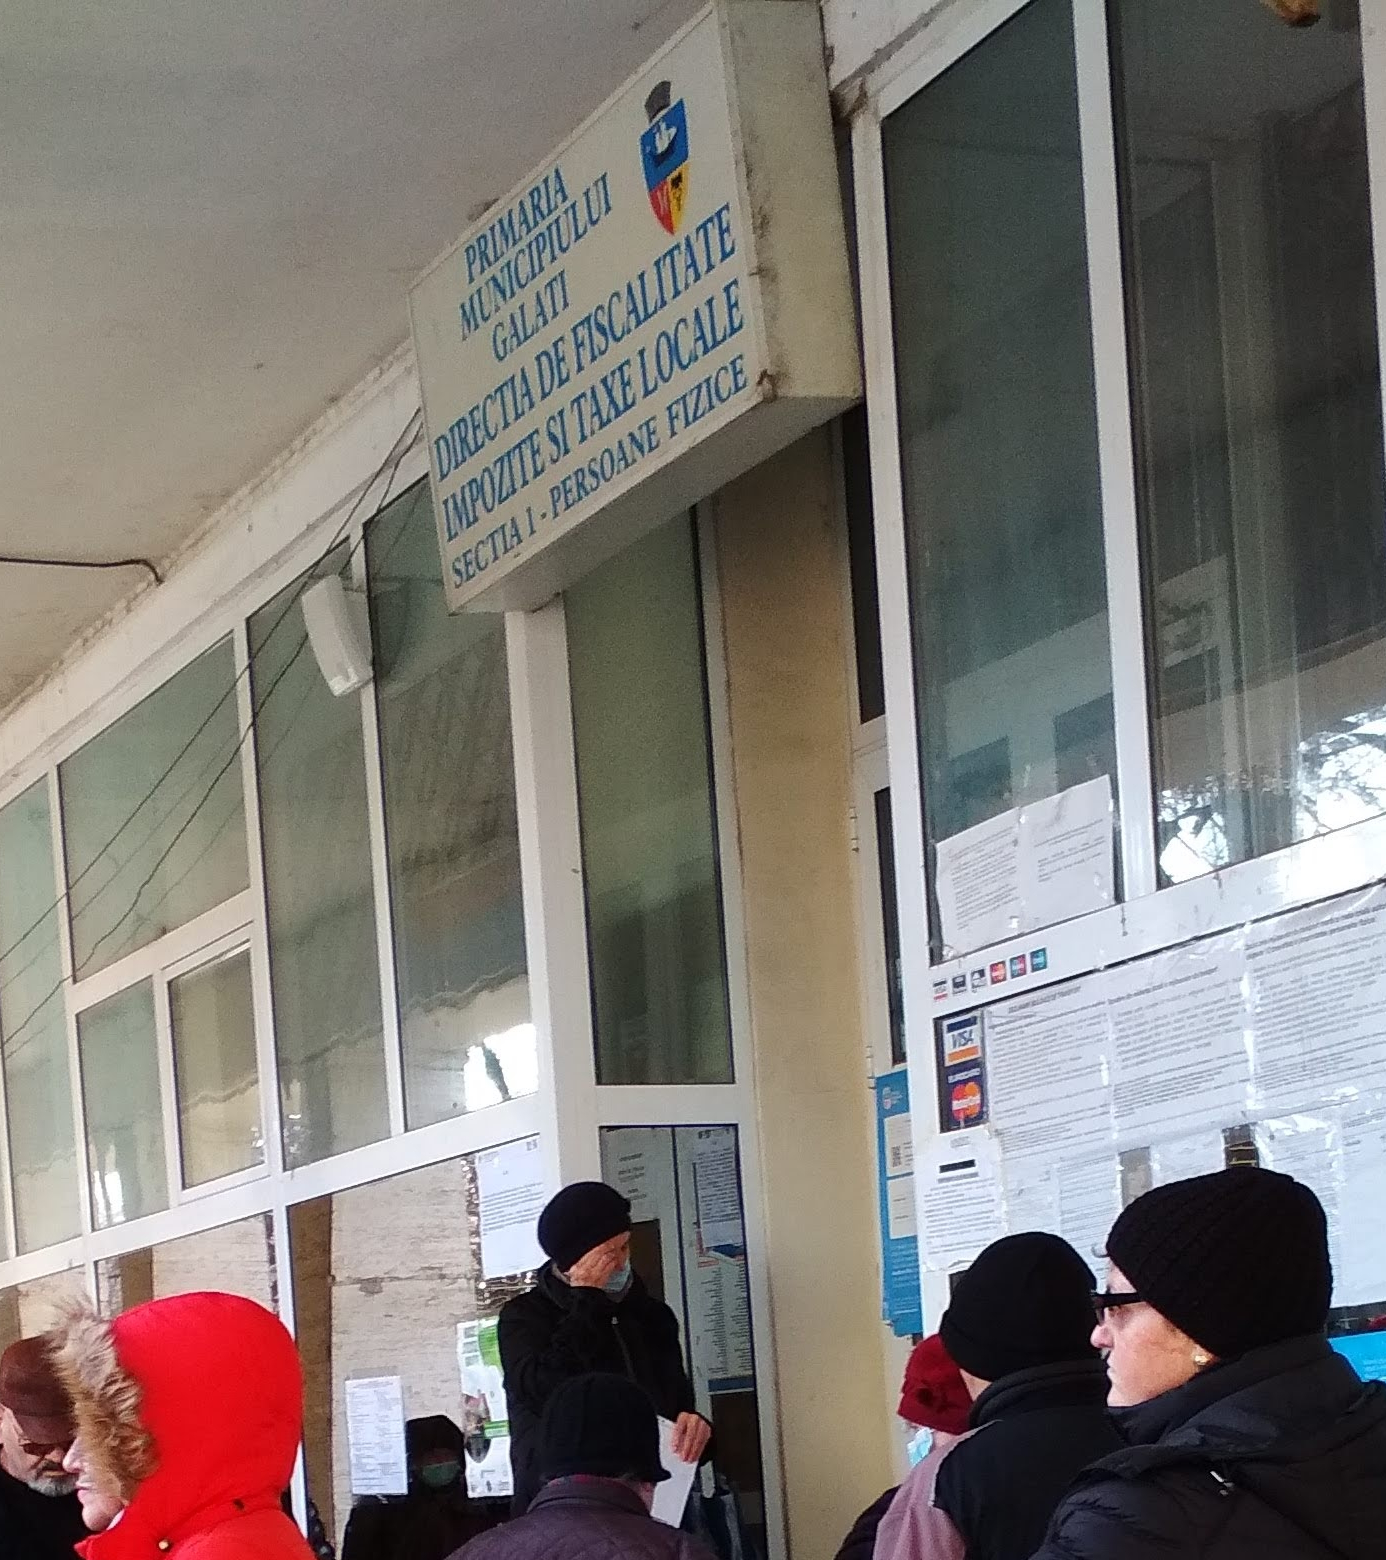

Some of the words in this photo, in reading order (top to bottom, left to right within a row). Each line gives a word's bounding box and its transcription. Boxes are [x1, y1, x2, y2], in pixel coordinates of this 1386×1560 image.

[458, 173, 612, 342] MUNICIPIULUI
[464, 162, 568, 286] PRIMARIA
[434, 370, 533, 483] DIRECTIA
[537, 342, 567, 402] DE
[571, 203, 737, 373] FISCALITATE
[491, 270, 569, 363] GALATI
[442, 428, 545, 543] IMPOZITE
[546, 411, 568, 465] SI
[570, 369, 636, 446] TAXE
[639, 278, 744, 397] LOCALE
[451, 517, 524, 589] SECTIA
[549, 424, 660, 520] PERSOANE
[667, 353, 748, 441] FIZICE
[950, 1029, 975, 1049] VISA
